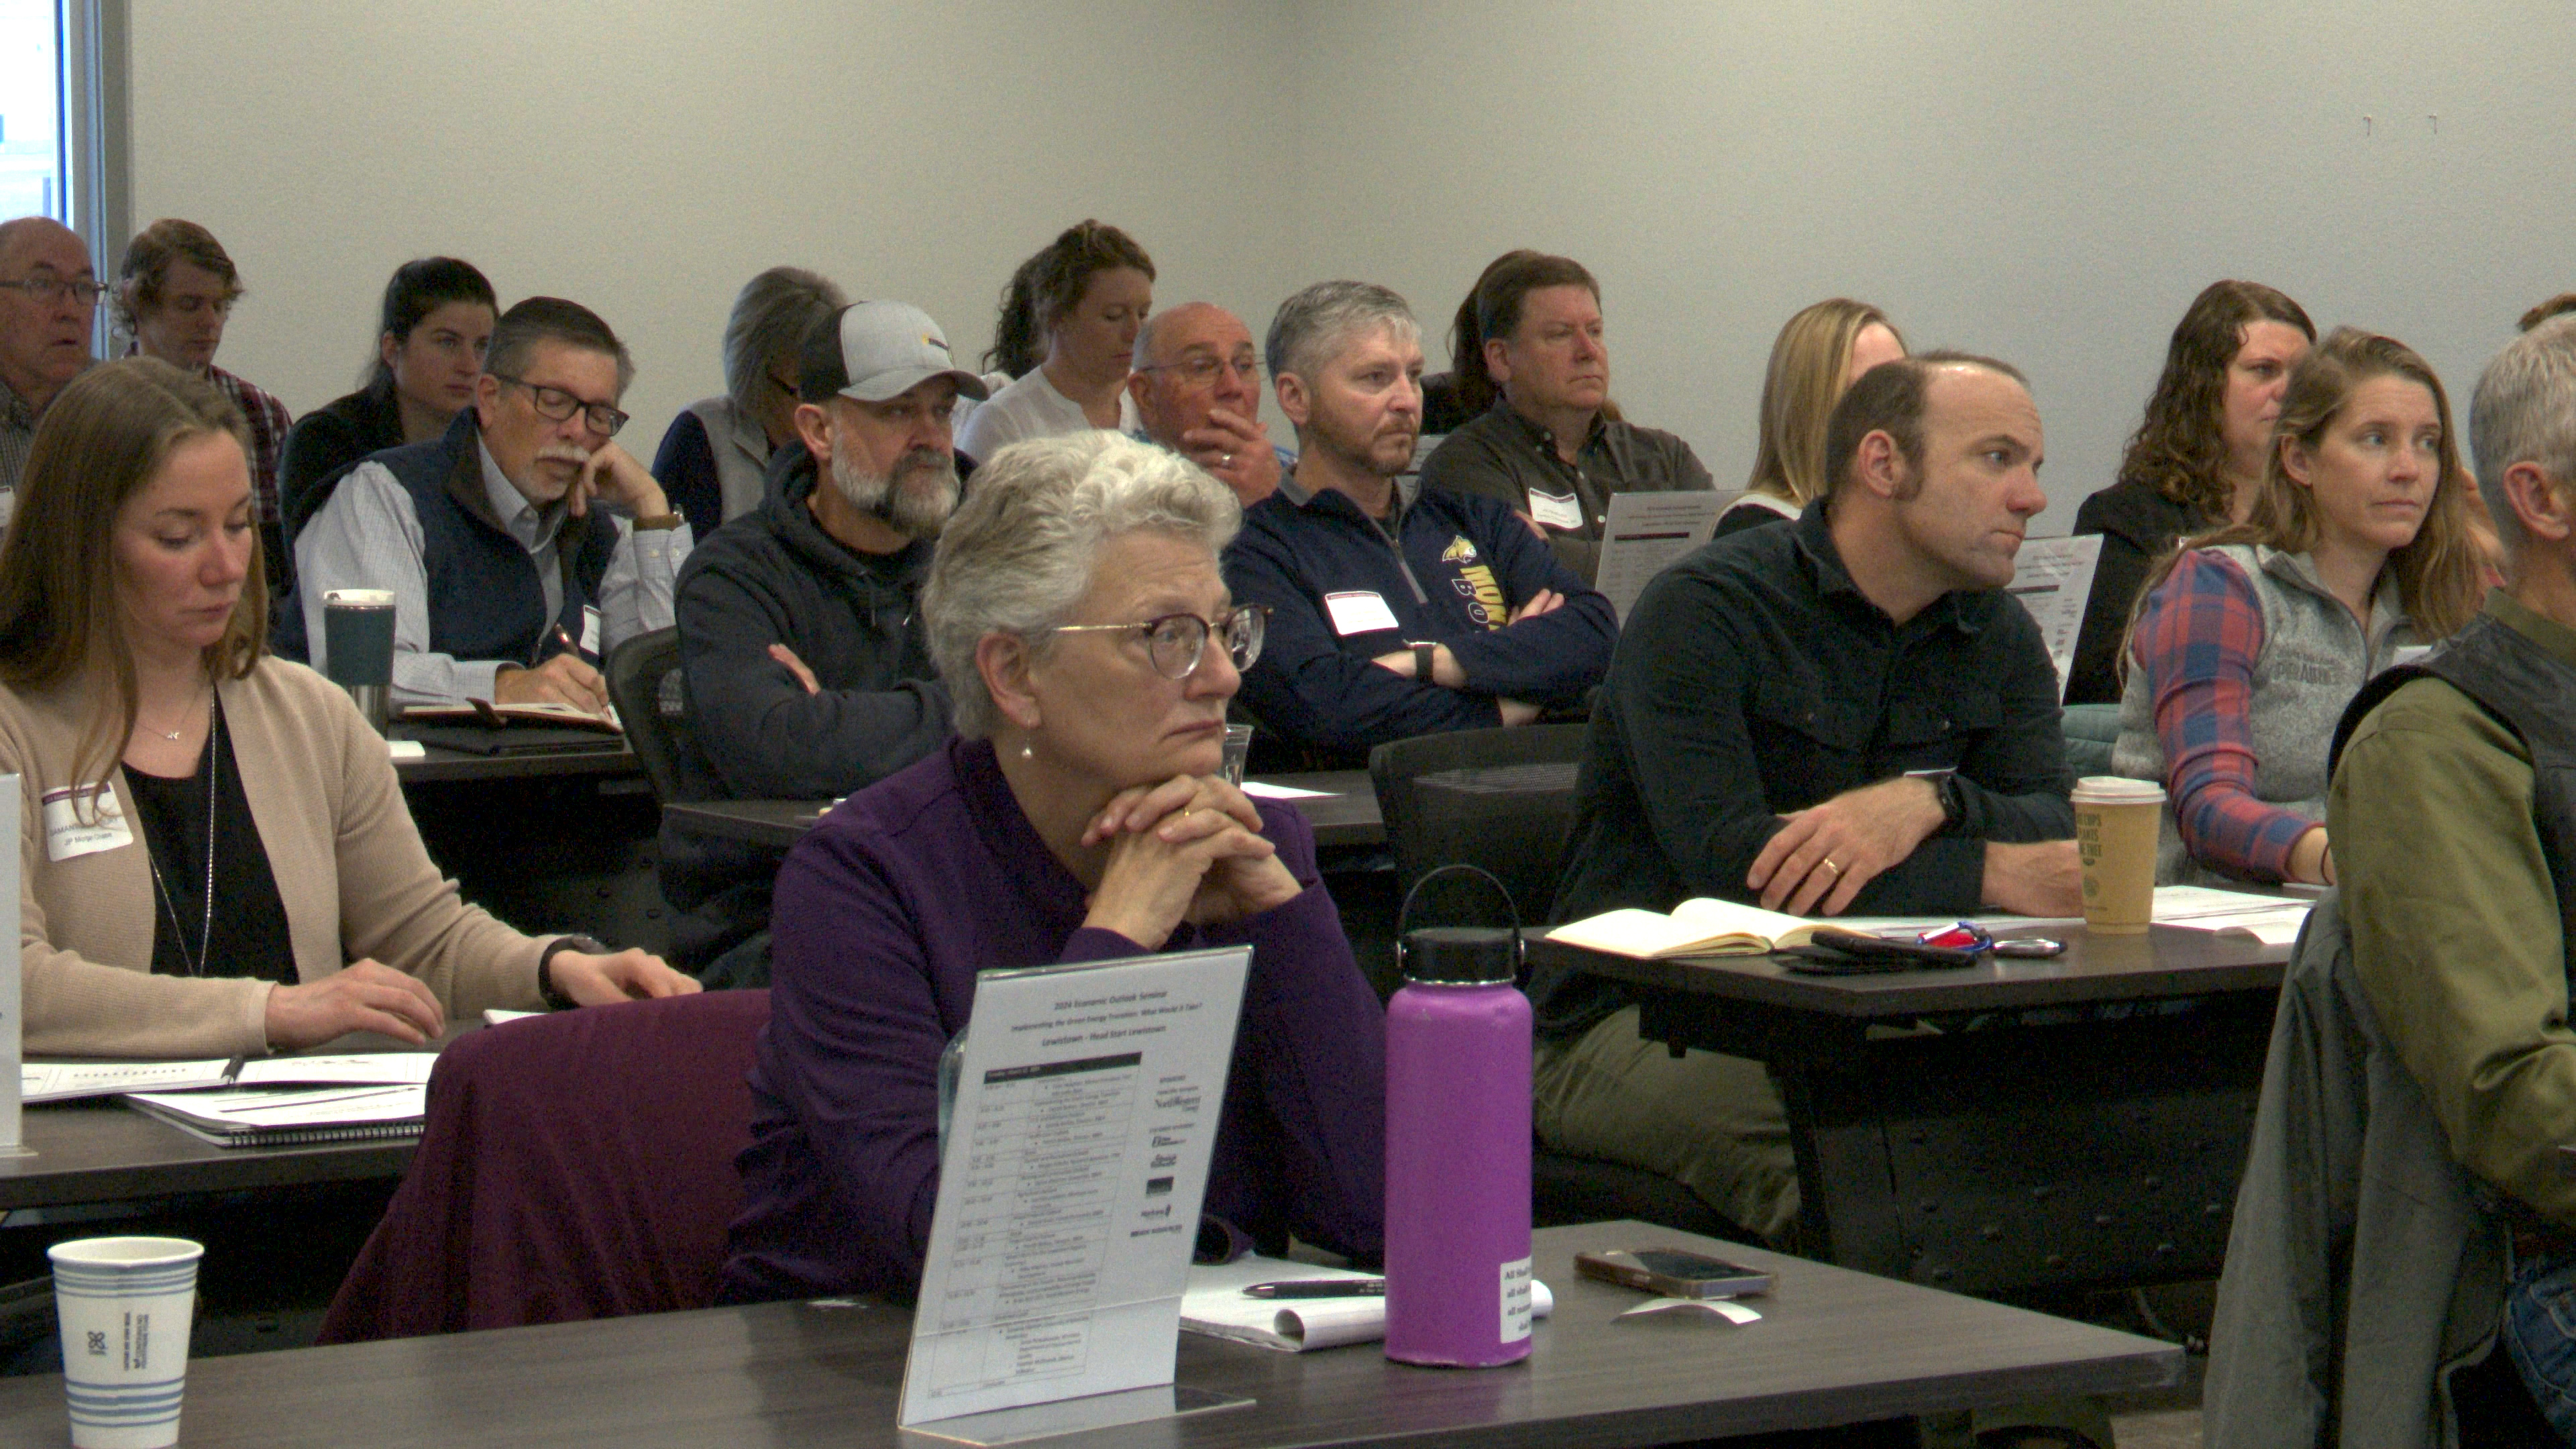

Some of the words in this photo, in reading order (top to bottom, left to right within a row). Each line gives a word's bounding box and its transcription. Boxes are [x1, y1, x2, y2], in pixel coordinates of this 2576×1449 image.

[1054, 1002, 1072, 1010] 2024
[1074, 998, 1107, 1008] Economic
[1109, 994, 1136, 1004] Outlook
[1140, 991, 1167, 1000] Seminar
[1141, 1008, 1157, 1016] What
[1159, 1005, 1178, 1014] Would
[1042, 1034, 1083, 1046] Lewistown
[1089, 1031, 1108, 1040] Head
[1110, 1028, 1127, 1038] Start
[1128, 1025, 1167, 1036] Lewistown
